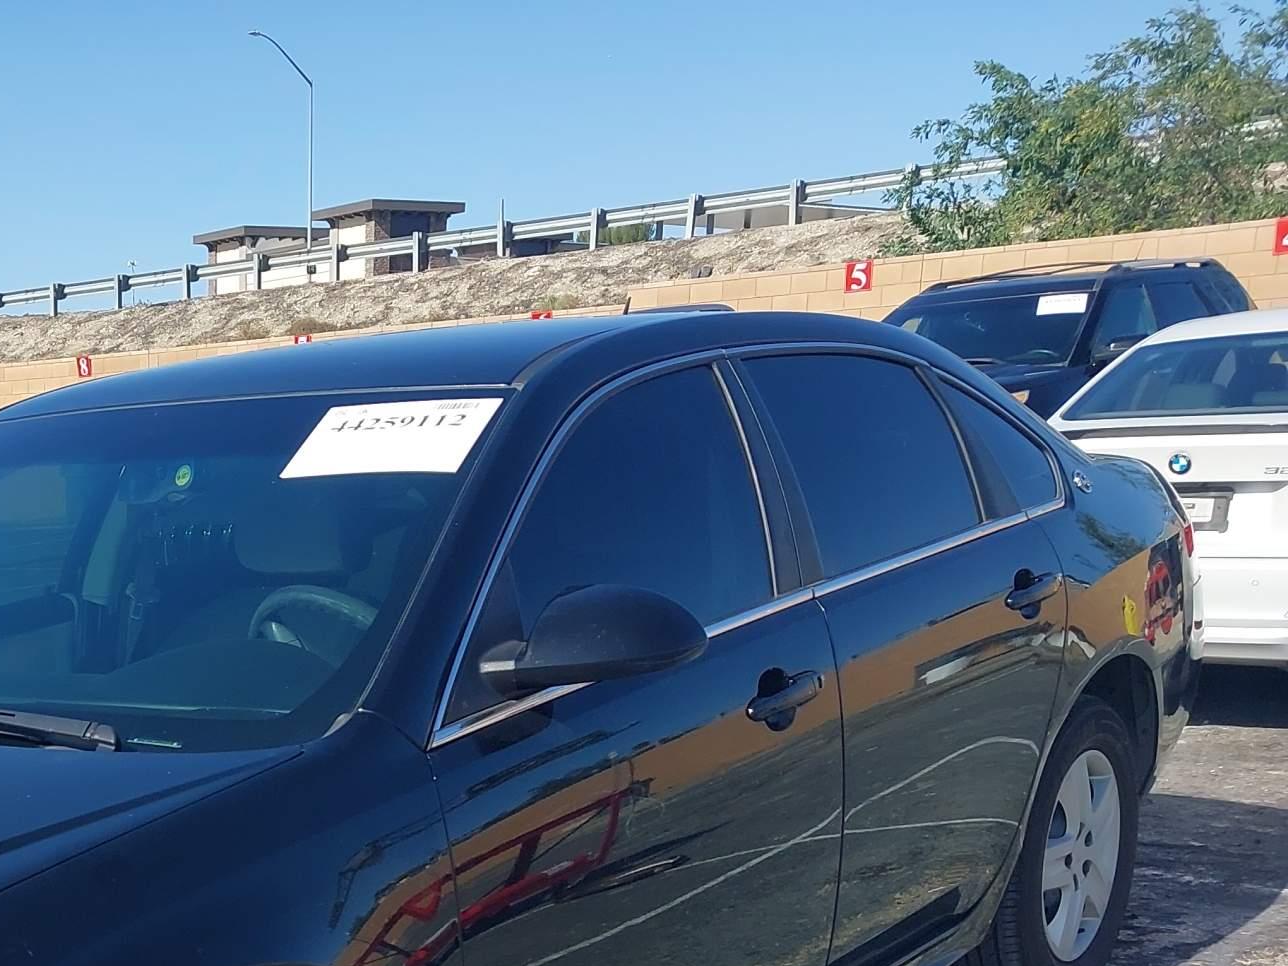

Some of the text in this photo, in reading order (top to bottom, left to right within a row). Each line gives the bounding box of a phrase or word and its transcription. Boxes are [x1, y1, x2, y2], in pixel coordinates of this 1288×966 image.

[850, 262, 868, 290] 5
[79, 357, 89, 376] 8
[330, 413, 467, 433] 44259112
